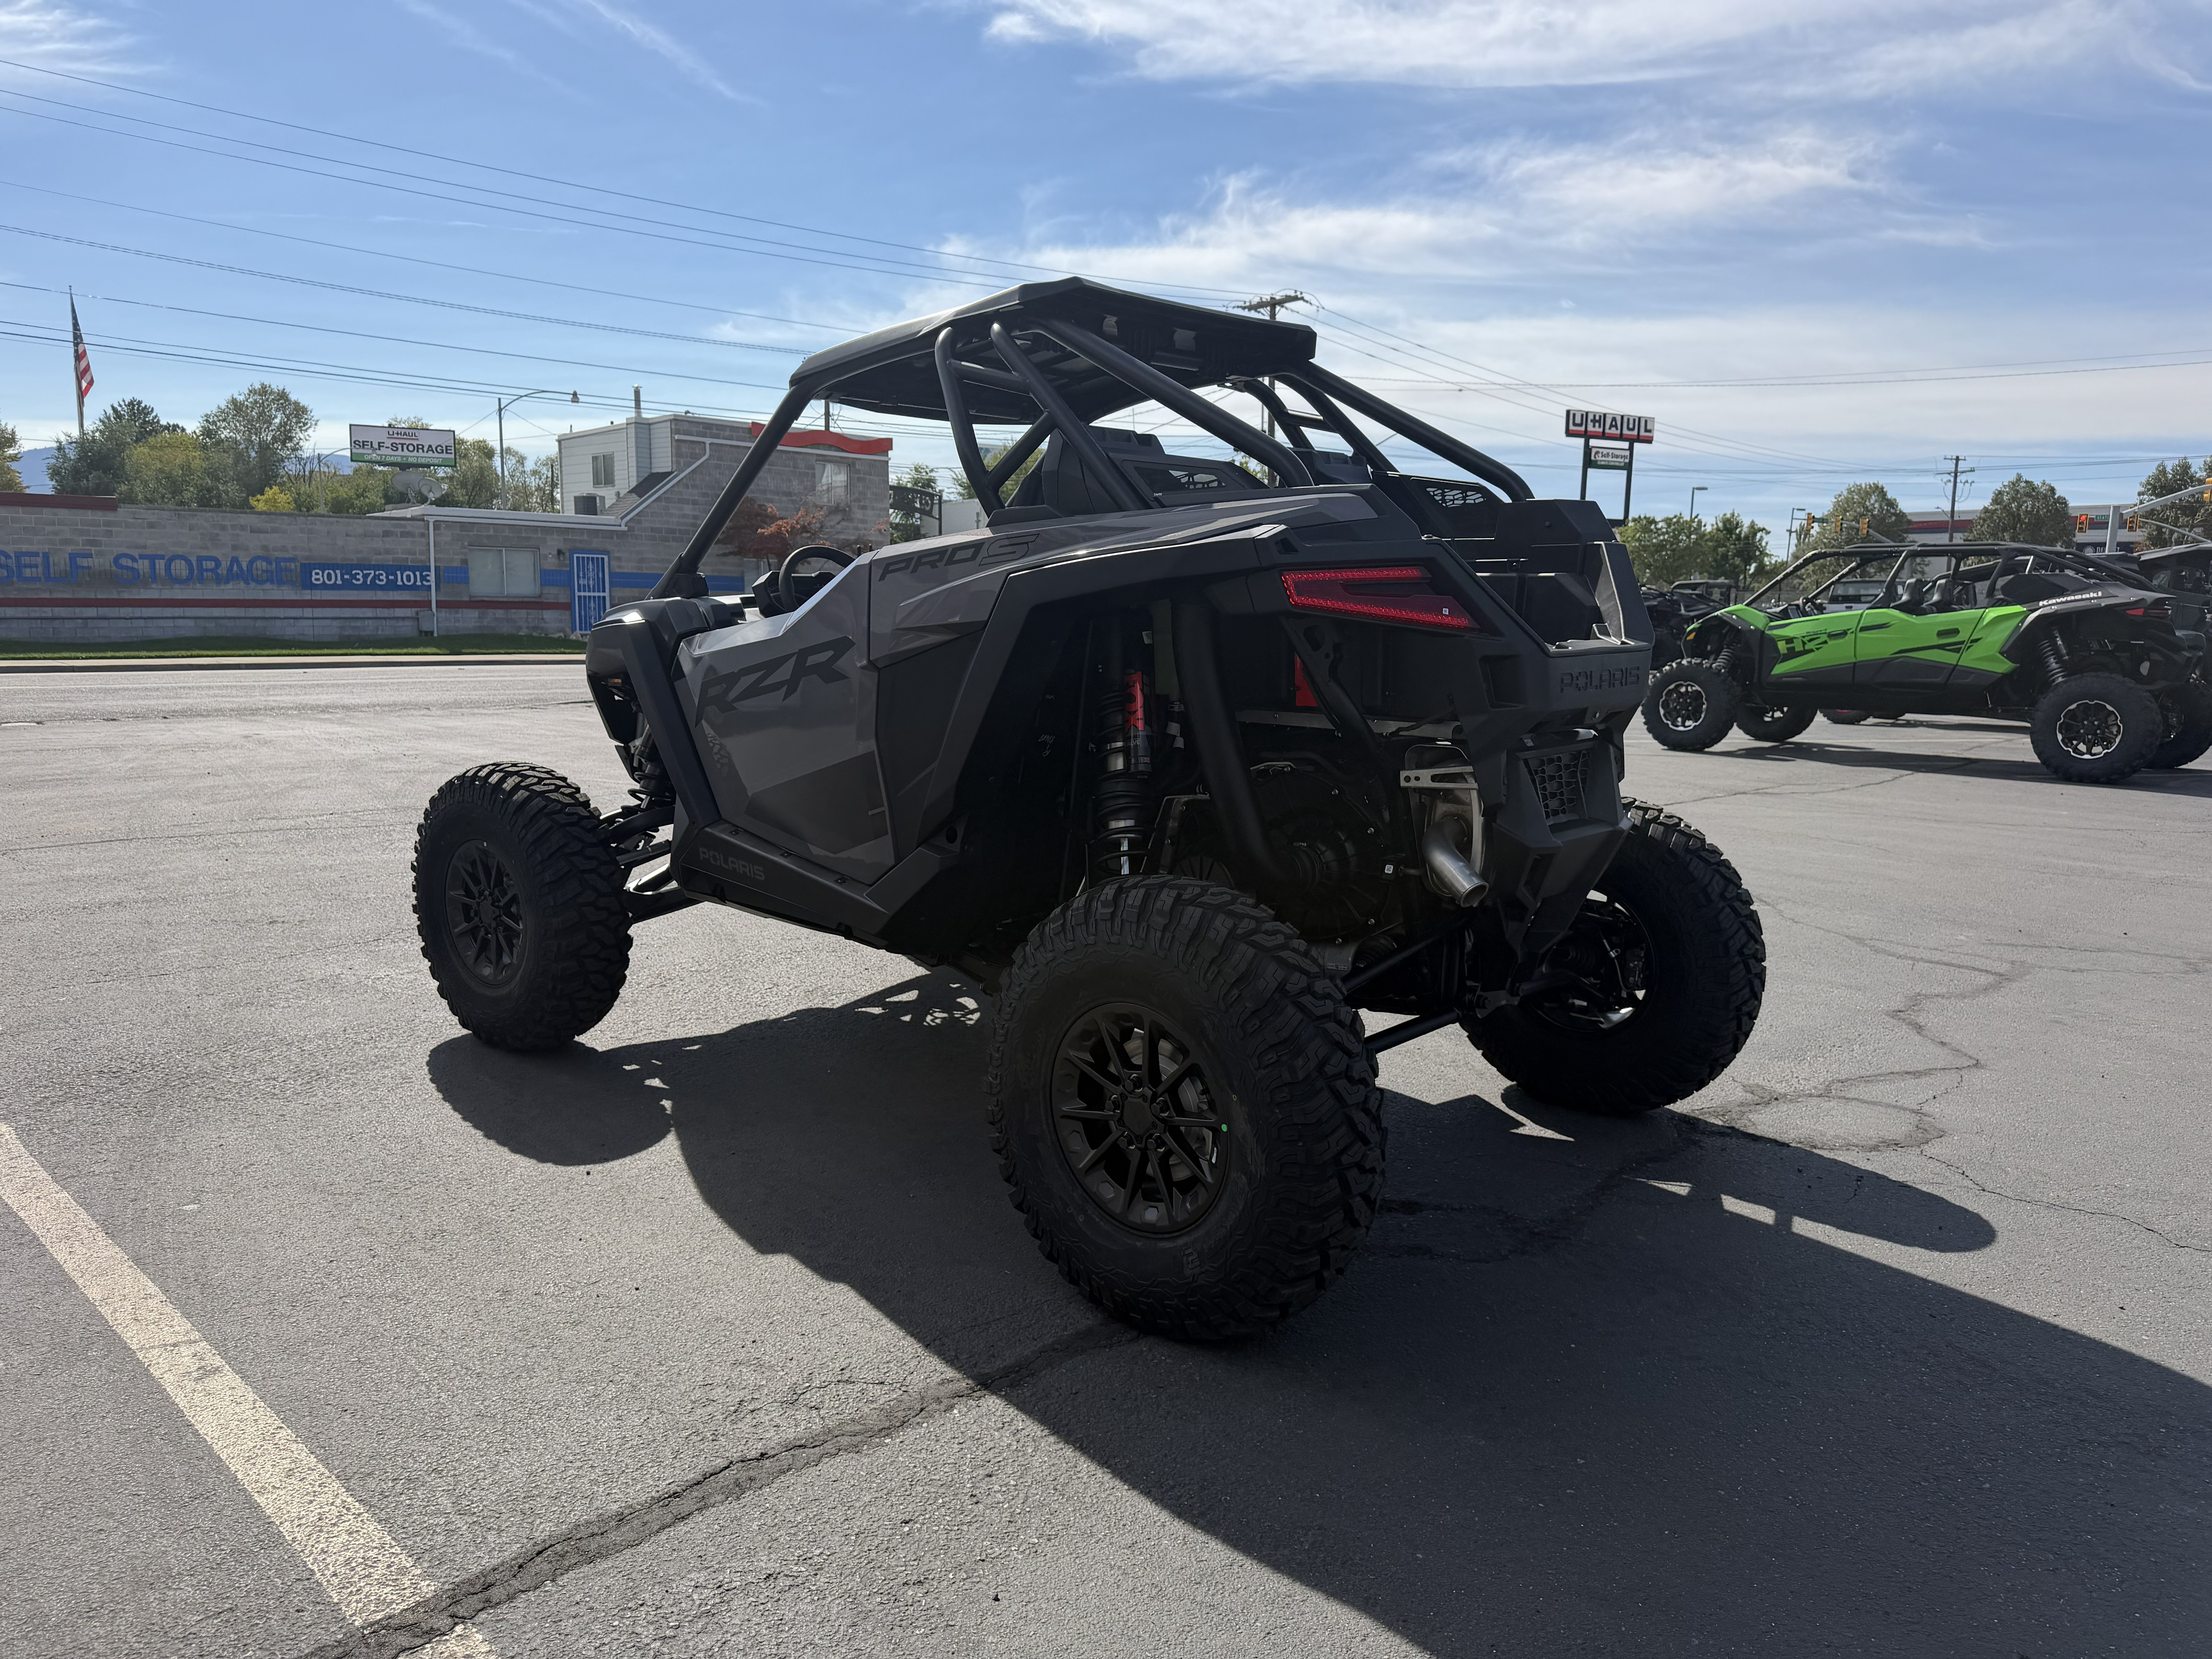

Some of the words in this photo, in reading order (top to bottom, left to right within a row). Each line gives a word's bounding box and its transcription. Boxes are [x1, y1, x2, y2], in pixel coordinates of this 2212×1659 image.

[353, 440, 453, 455] SELF-STORAGE
[112, 552, 298, 586] STORAGE
[878, 542, 986, 581] PRO
[311, 569, 432, 586] 801-373-1013
[2039, 591, 2102, 606] Kawasaki
[695, 635, 856, 728] RZR
[1560, 666, 1640, 694] POLARIS
[699, 847, 765, 881] POLARIS
